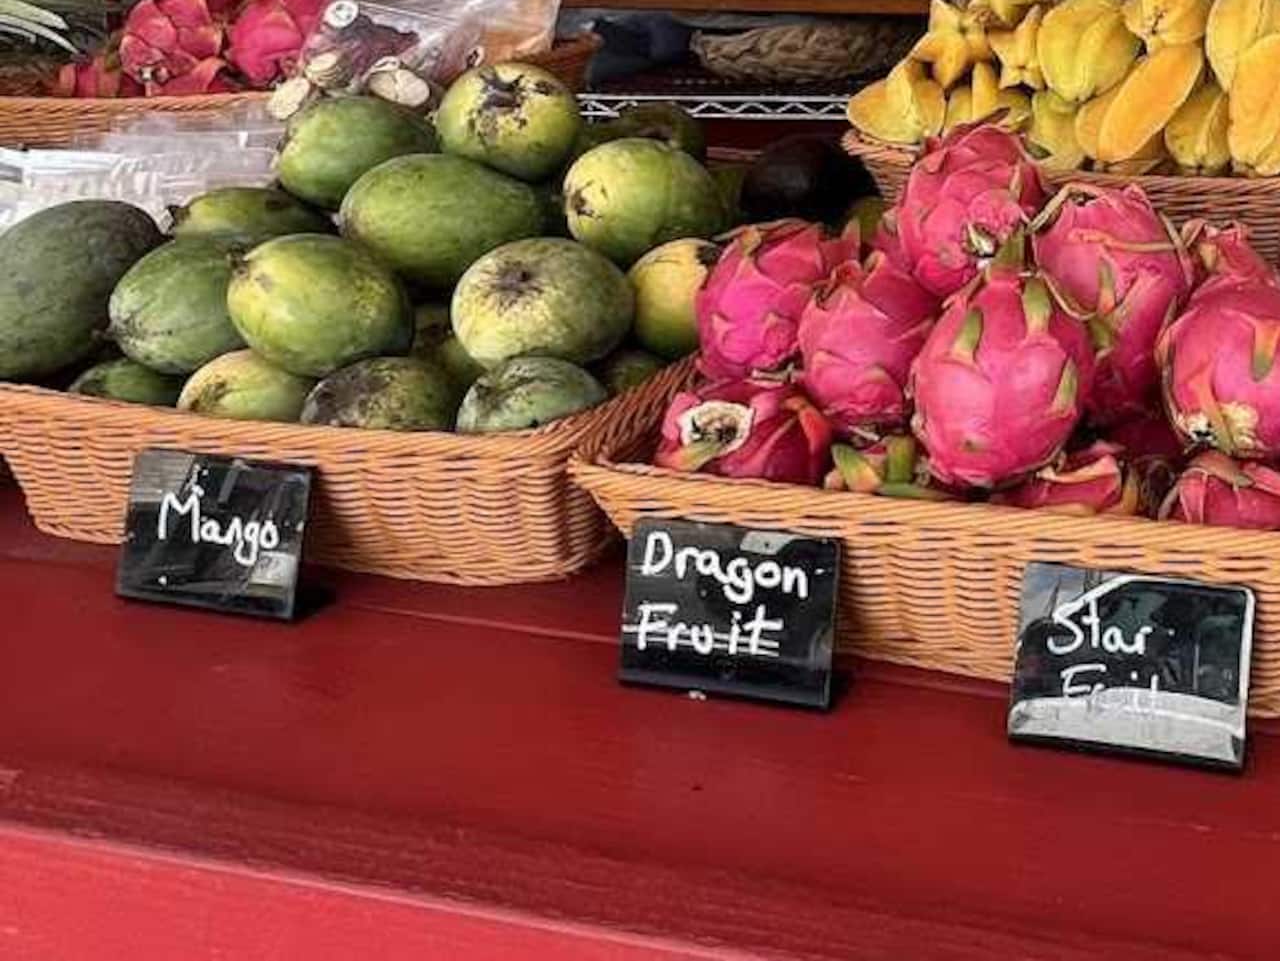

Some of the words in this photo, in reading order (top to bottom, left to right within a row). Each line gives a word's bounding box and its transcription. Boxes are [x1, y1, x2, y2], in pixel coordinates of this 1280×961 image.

[157, 486, 280, 567] Mango
[641, 530, 809, 604] Dragon
[637, 602, 785, 656] Fruit
[1047, 595, 1154, 656] Star
